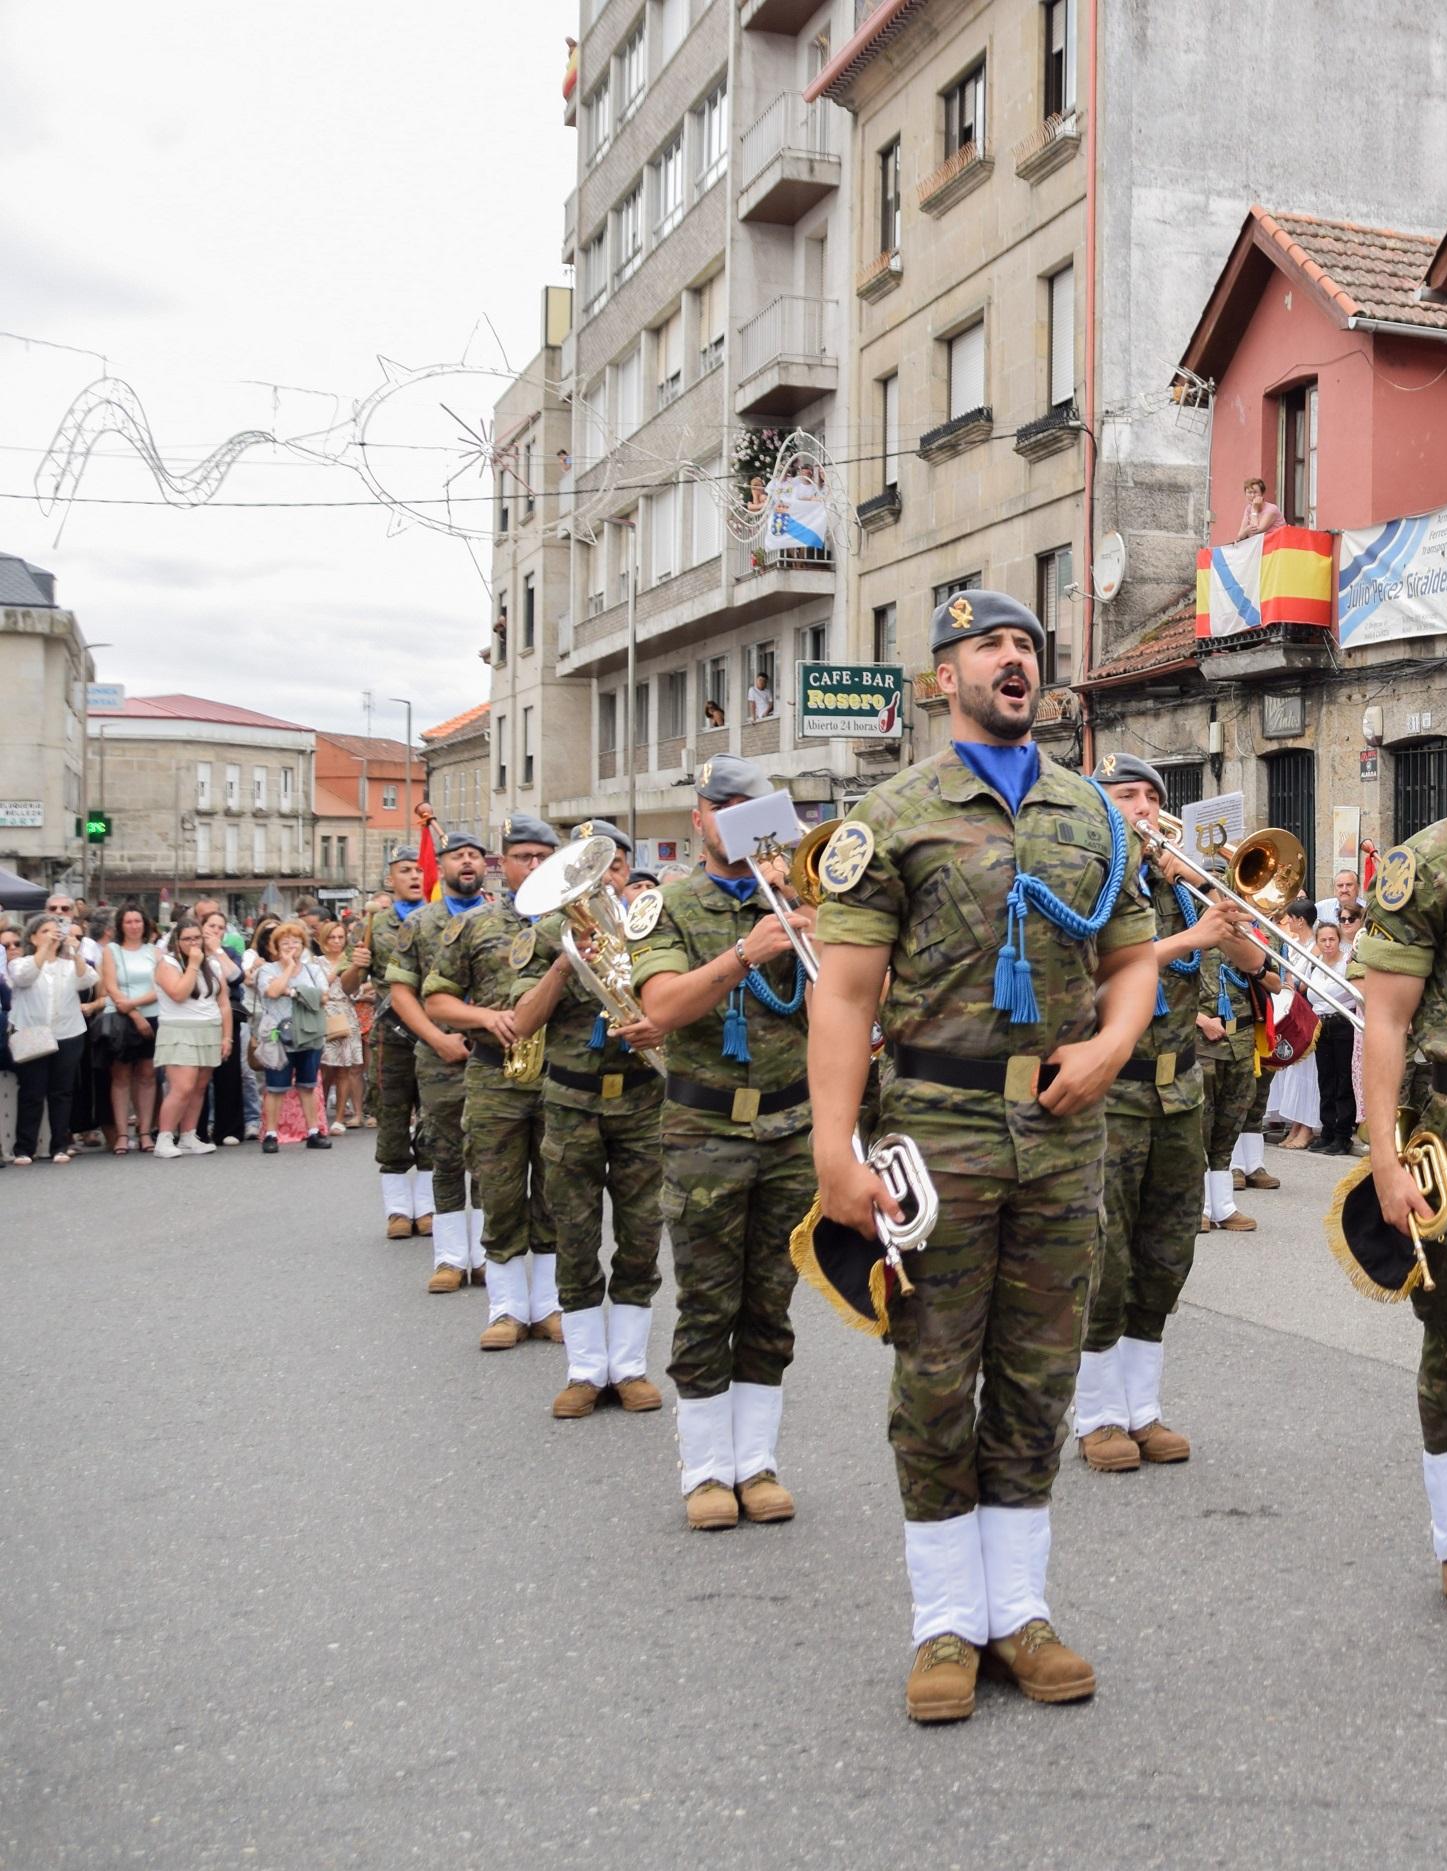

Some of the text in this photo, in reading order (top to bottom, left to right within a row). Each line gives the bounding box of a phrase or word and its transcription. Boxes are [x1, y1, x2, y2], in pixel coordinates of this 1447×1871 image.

[1347, 583, 1370, 609] Julio
[806, 720, 878, 731] Abierto 24 horas
